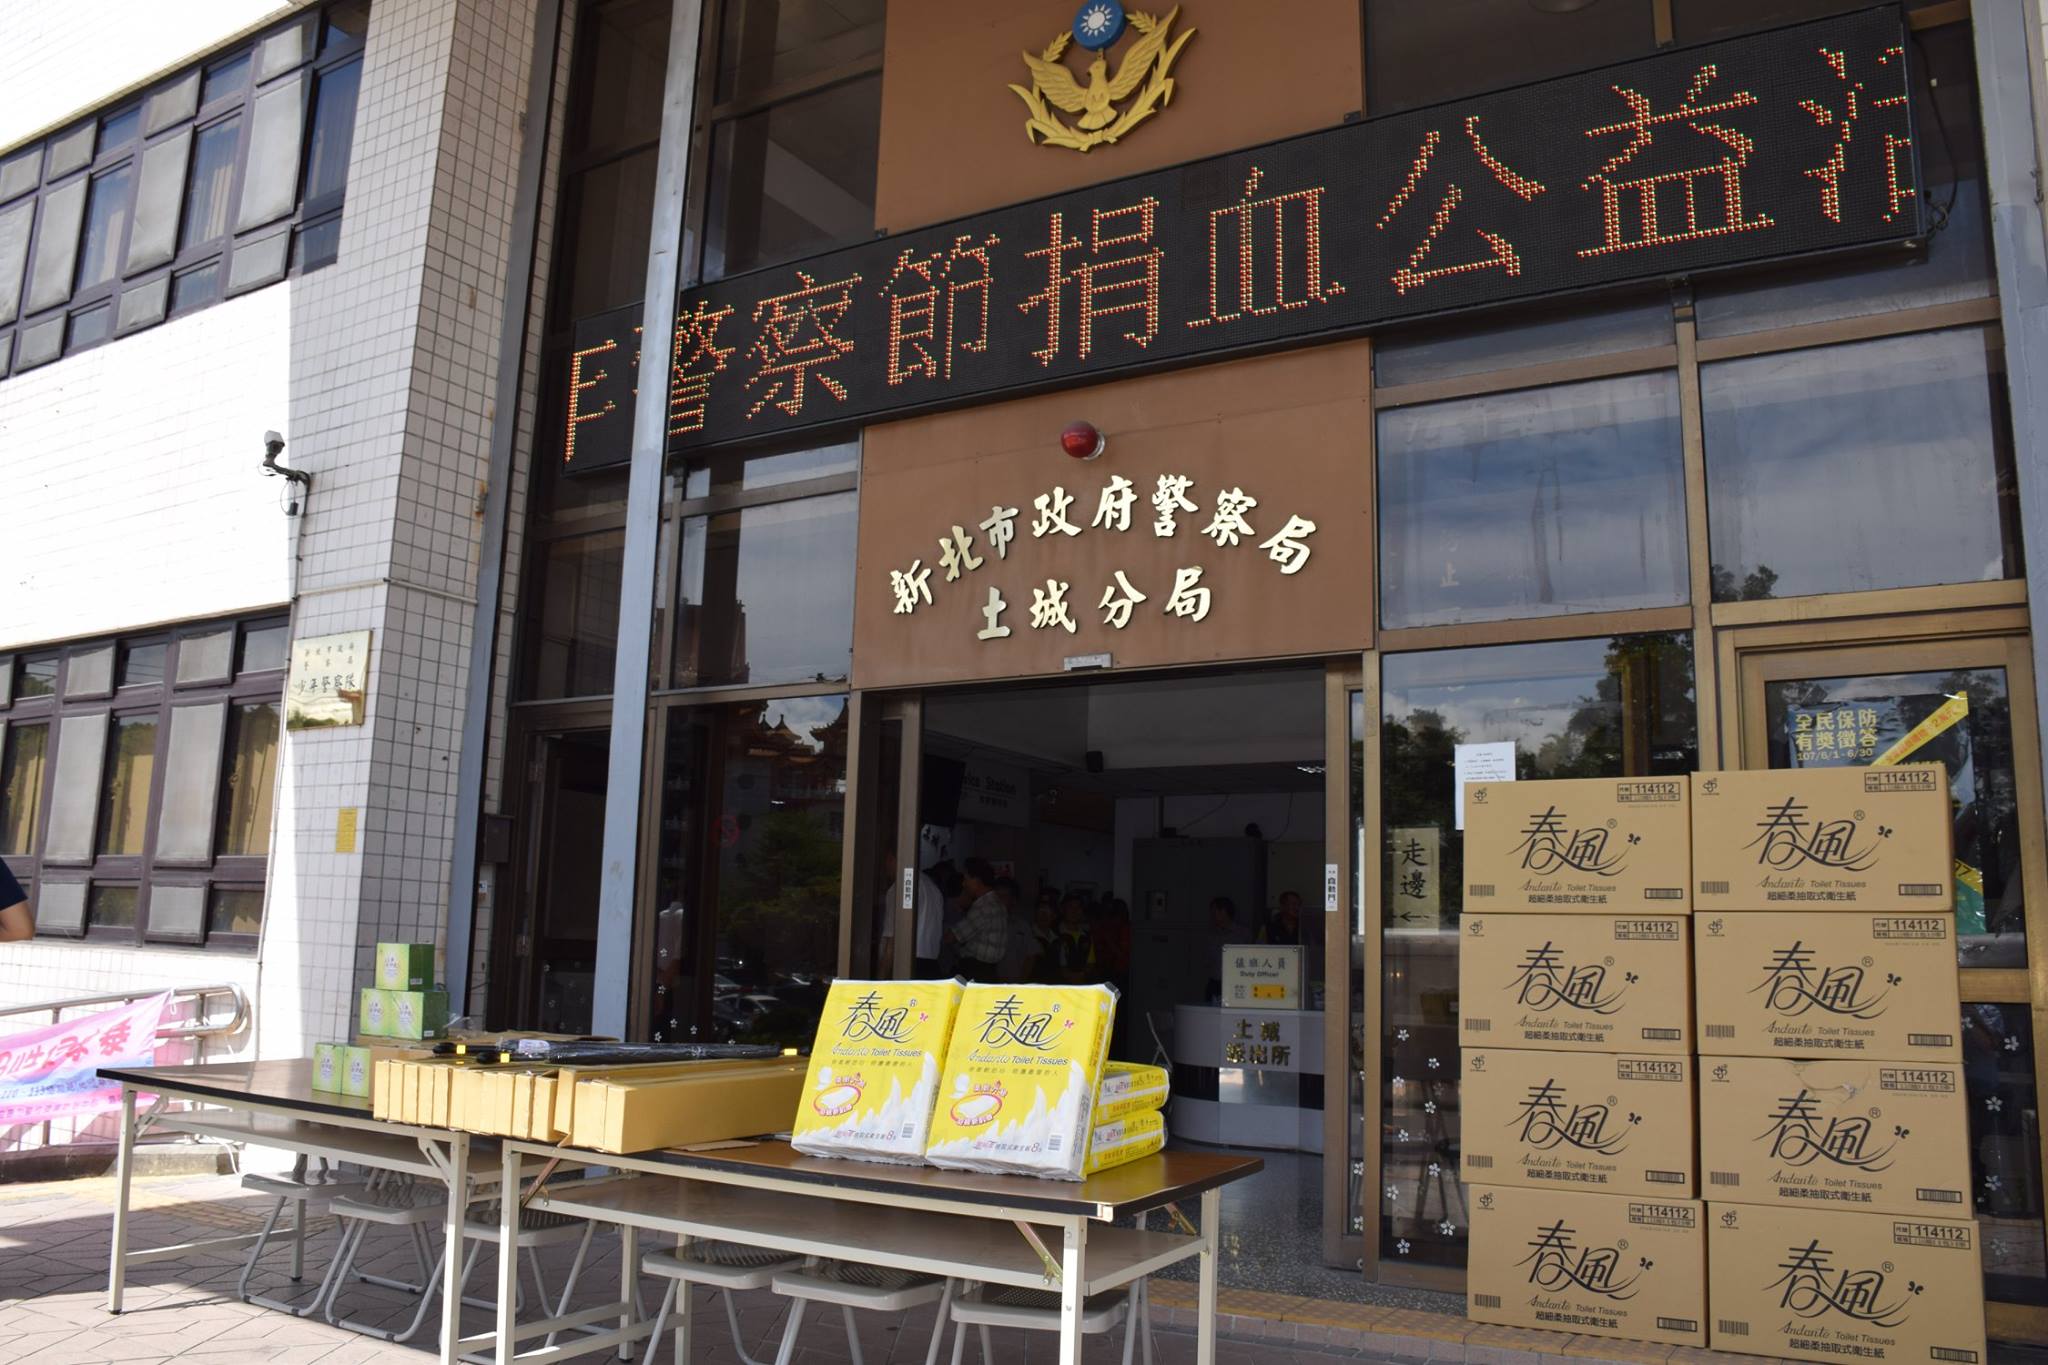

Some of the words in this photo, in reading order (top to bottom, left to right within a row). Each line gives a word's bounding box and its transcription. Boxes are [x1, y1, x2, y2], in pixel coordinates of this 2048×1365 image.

[889, 474, 1317, 615] 新北市政府警察局
[977, 565, 1213, 641] 土城分局
[1795, 708, 1878, 732] 全民保防
[1795, 729, 1878, 751] 有獎徵答
[1884, 772, 1930, 784] 114112
[1635, 783, 1676, 794] 114112
[1507, 805, 1631, 876] 春風
[1742, 796, 1882, 872] 春風
[1567, 884, 1587, 892] Toilet
[1588, 884, 1617, 892] Tissues
[1810, 880, 1833, 888] Toilet
[1834, 880, 1867, 888] Tissues
[1528, 895, 1608, 905] 超細柔抽取式衛生紙
[1767, 891, 1857, 901] 超細柔抽取式衛生紙
[1632, 921, 1673, 933] 114112
[1893, 919, 1940, 931] 114112
[1503, 941, 1628, 1015] 春風
[1747, 940, 1890, 1020] 春風
[837, 990, 921, 1043] 春風
[970, 994, 1064, 1051] 春風
[1233, 1018, 1280, 1042] 土城
[1563, 1022, 1584, 1030] Toilet
[1585, 1022, 1614, 1031] Tissues
[1818, 1026, 1841, 1035] Toilet
[1842, 1027, 1875, 1037] Tissues
[1524, 1031, 1605, 1042] 超細柔抽取式衛生紙
[1774, 1037, 1865, 1050] 超細柔抽取式衛生紙
[871, 1048, 891, 1056] Toilet
[894, 1048, 923, 1057] Tissues
[1012, 1056, 1033, 1064] Toilet
[1037, 1057, 1068, 1066] Tissues
[1636, 1061, 1677, 1074] 114112
[1901, 1071, 1948, 1084] 114112
[1504, 1078, 1632, 1155] 春風
[1752, 1089, 1897, 1173] 春風
[1566, 1161, 1586, 1169] Toilet
[1588, 1162, 1617, 1172] Tissues
[1527, 1169, 1608, 1184] 超細柔抽取式衛生紙
[1824, 1178, 1847, 1188] Toilet
[1850, 1179, 1883, 1190] Tissues
[1779, 1187, 1873, 1203] 超細柔抽取式衛生紙
[1647, 1206, 1689, 1219] 114112
[1914, 1225, 1964, 1240] 114112
[1514, 1219, 1642, 1300] 春風
[1761, 1239, 1914, 1327] 春風
[1576, 1304, 1597, 1313] Toilet
[1598, 1306, 1628, 1317] Tissues
[1535, 1311, 1618, 1328] 超細柔抽取式衛生紙
[1836, 1331, 1859, 1341] Toilet
[1861, 1333, 1896, 1346] Tissues
[1789, 1338, 1885, 1359] 超細柔抽取式衛生紙
